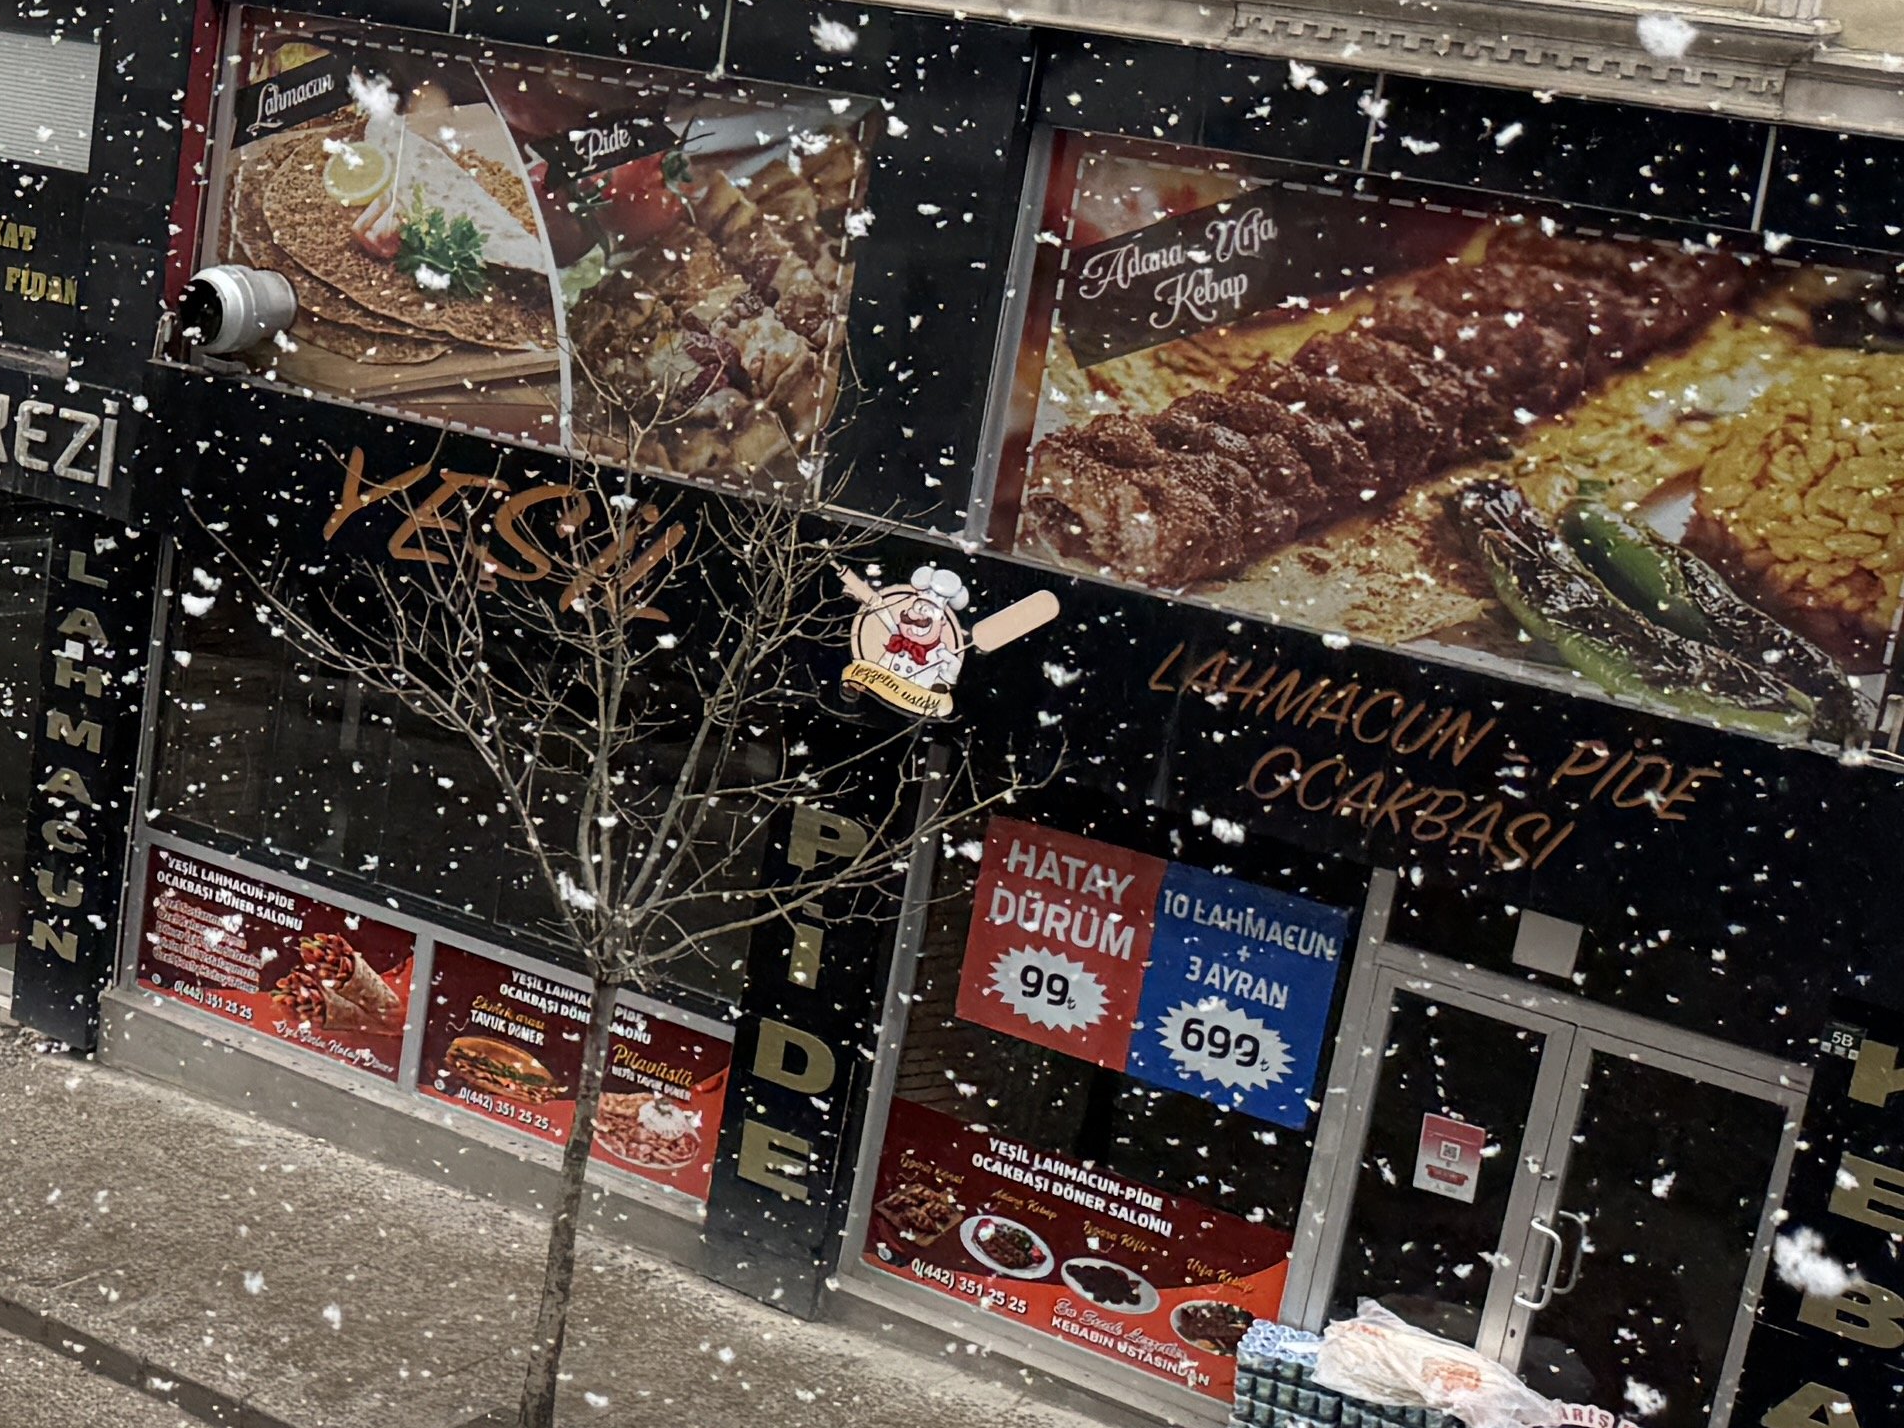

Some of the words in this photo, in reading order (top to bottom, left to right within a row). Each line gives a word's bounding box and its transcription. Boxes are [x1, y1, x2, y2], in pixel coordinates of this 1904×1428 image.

[247, 71, 336, 134] Lahmacun
[573, 125, 632, 174] Pide
[4, 262, 79, 307] FİDAN
[1078, 243, 1185, 300] Adana
[1205, 207, 1279, 263] Urfa
[1149, 267, 1249, 329] Kebap
[31, 550, 109, 964] LAHMACUN
[1147, 640, 1497, 768] LAHMACUN
[1546, 737, 1723, 822] PİDE
[156, 870, 214, 903] OCAKBAŞI
[256, 903, 303, 932] SALONU
[168, 856, 199, 878] YEŞİL
[200, 865, 296, 912] LAHMACUN-PİDE
[1007, 839, 1136, 906] HATAY
[989, 886, 1136, 961] DÜRÜM
[1163, 889, 1189, 919] 10
[1192, 898, 1338, 962] LAHMACUN
[498, 983, 560, 1015] OCAKBAŞI
[511, 969, 544, 994] YEŞİL
[1185, 955, 1202, 983] 3
[1203, 962, 1290, 1011] AYRAN
[469, 1009, 506, 1033] TAVUK
[507, 1022, 545, 1047] DÖNER
[459, 1086, 493, 1113] 0(442)
[495, 1098, 515, 1118] 351
[517, 1107, 533, 1124] 25
[533, 1113, 549, 1130] 25
[971, 1152, 1050, 1194] OCAKBAŞI
[1050, 1180, 1106, 1214] DÖNER
[1107, 1200, 1173, 1239] SALONU
[988, 1137, 1031, 1167] YEŞİL
[1032, 1152, 1164, 1213] LAHMACUN-PİDE
[911, 1257, 956, 1292] 0(442)
[958, 1275, 984, 1298] 351
[987, 1288, 1006, 1307] 25
[1007, 1295, 1028, 1315] 25
[1050, 1314, 1115, 1351] KEBABIN
